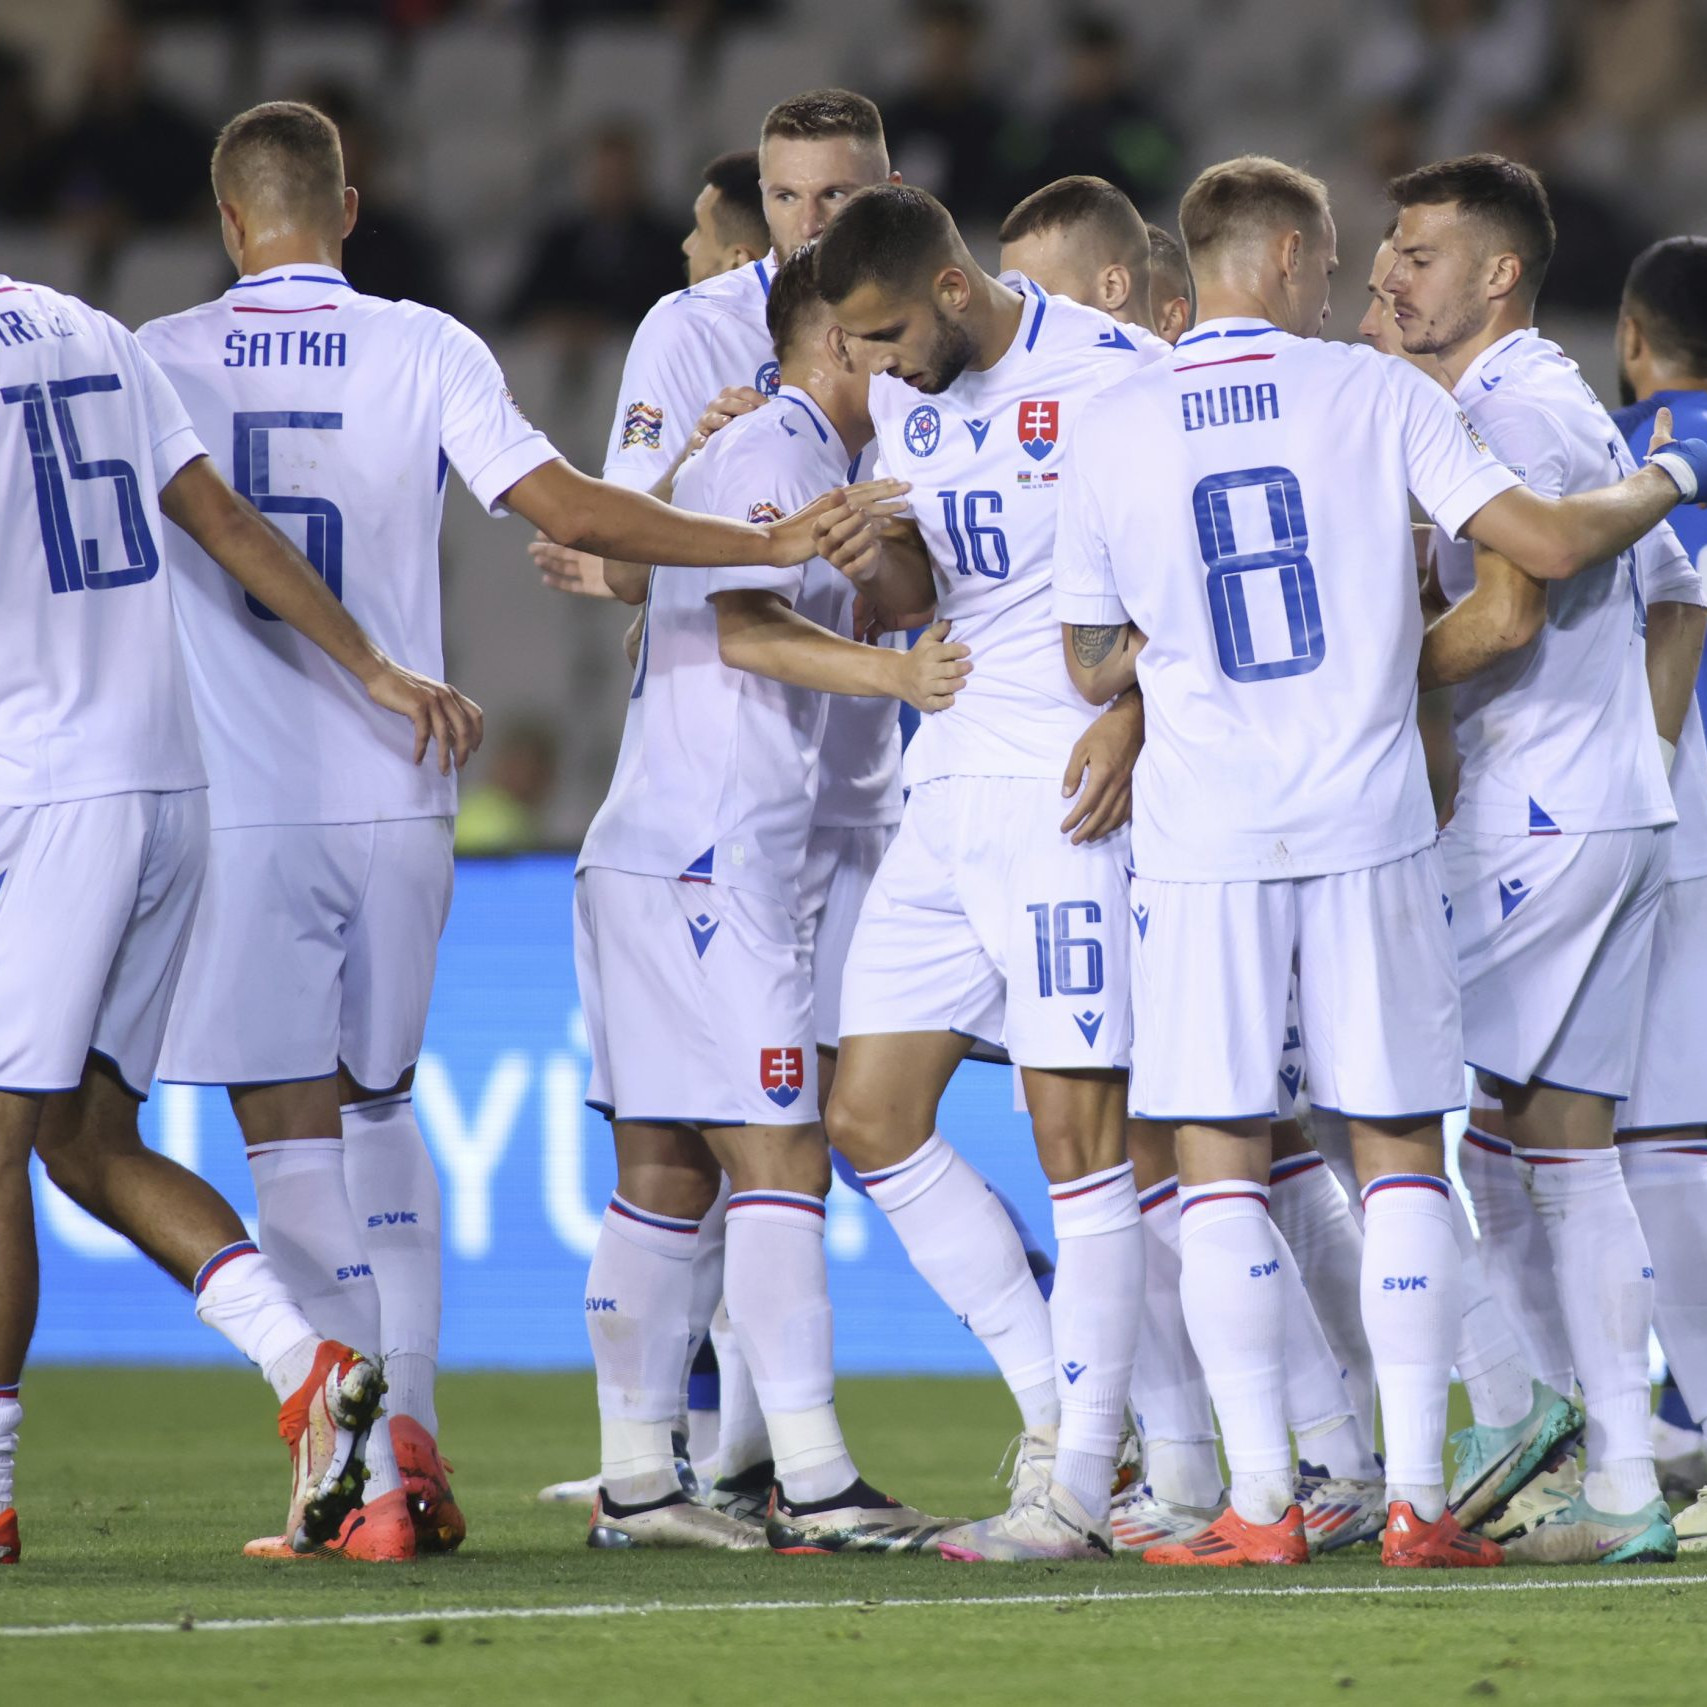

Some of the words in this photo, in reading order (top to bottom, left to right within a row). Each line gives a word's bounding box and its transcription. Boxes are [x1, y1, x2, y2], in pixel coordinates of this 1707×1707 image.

[223, 329, 346, 367] ŠATKA
[1181, 382, 1280, 432] DUDA
[0, 374, 160, 595] 15
[232, 411, 343, 622] 5
[936, 489, 1011, 580] 16
[1192, 465, 1326, 683] 8
[1026, 900, 1104, 998] 16
[367, 1211, 418, 1228] SVK
[336, 1263, 374, 1281] SVK
[1250, 1259, 1280, 1277] SVK
[1382, 1275, 1428, 1290] SVK
[585, 1296, 617, 1311] SVK
